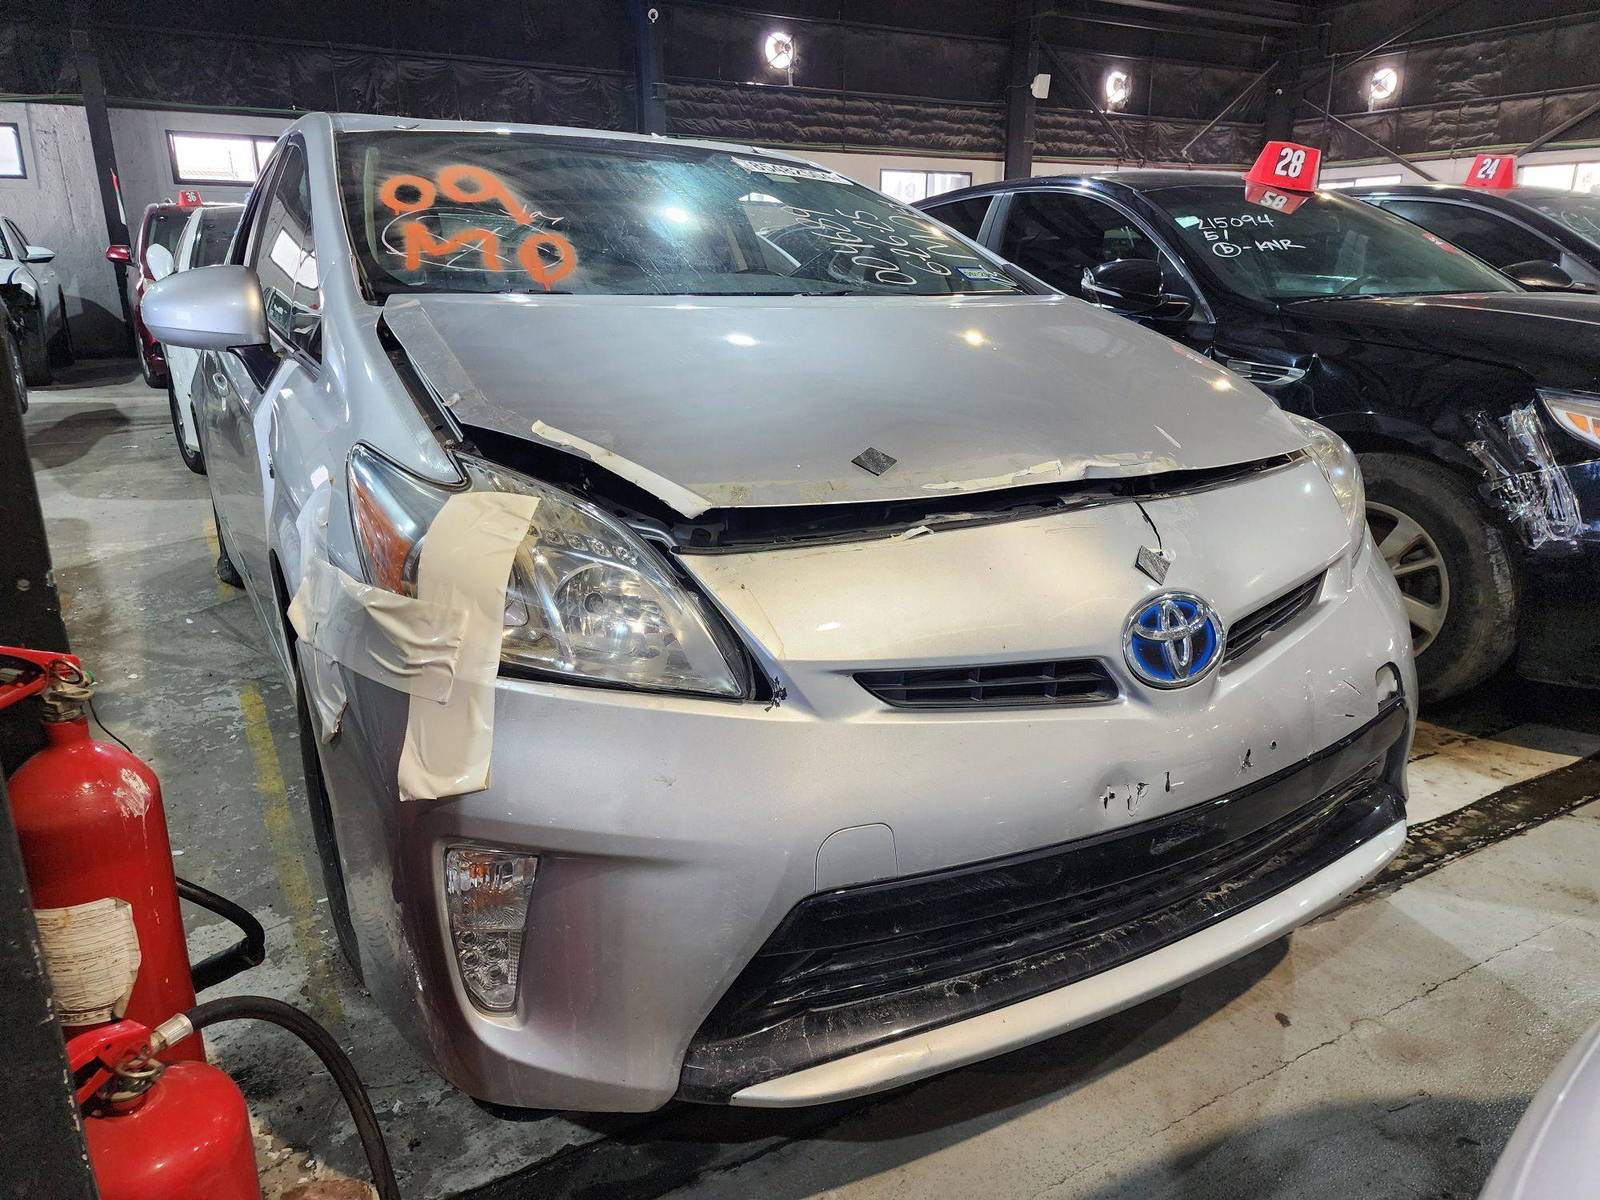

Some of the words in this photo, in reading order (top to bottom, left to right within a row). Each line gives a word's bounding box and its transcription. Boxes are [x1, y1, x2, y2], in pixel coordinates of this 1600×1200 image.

[1274, 147, 1306, 178] 28
[1476, 158, 1501, 179] 24
[1198, 213, 1275, 229] 215094
[1203, 229, 1229, 241] 51
